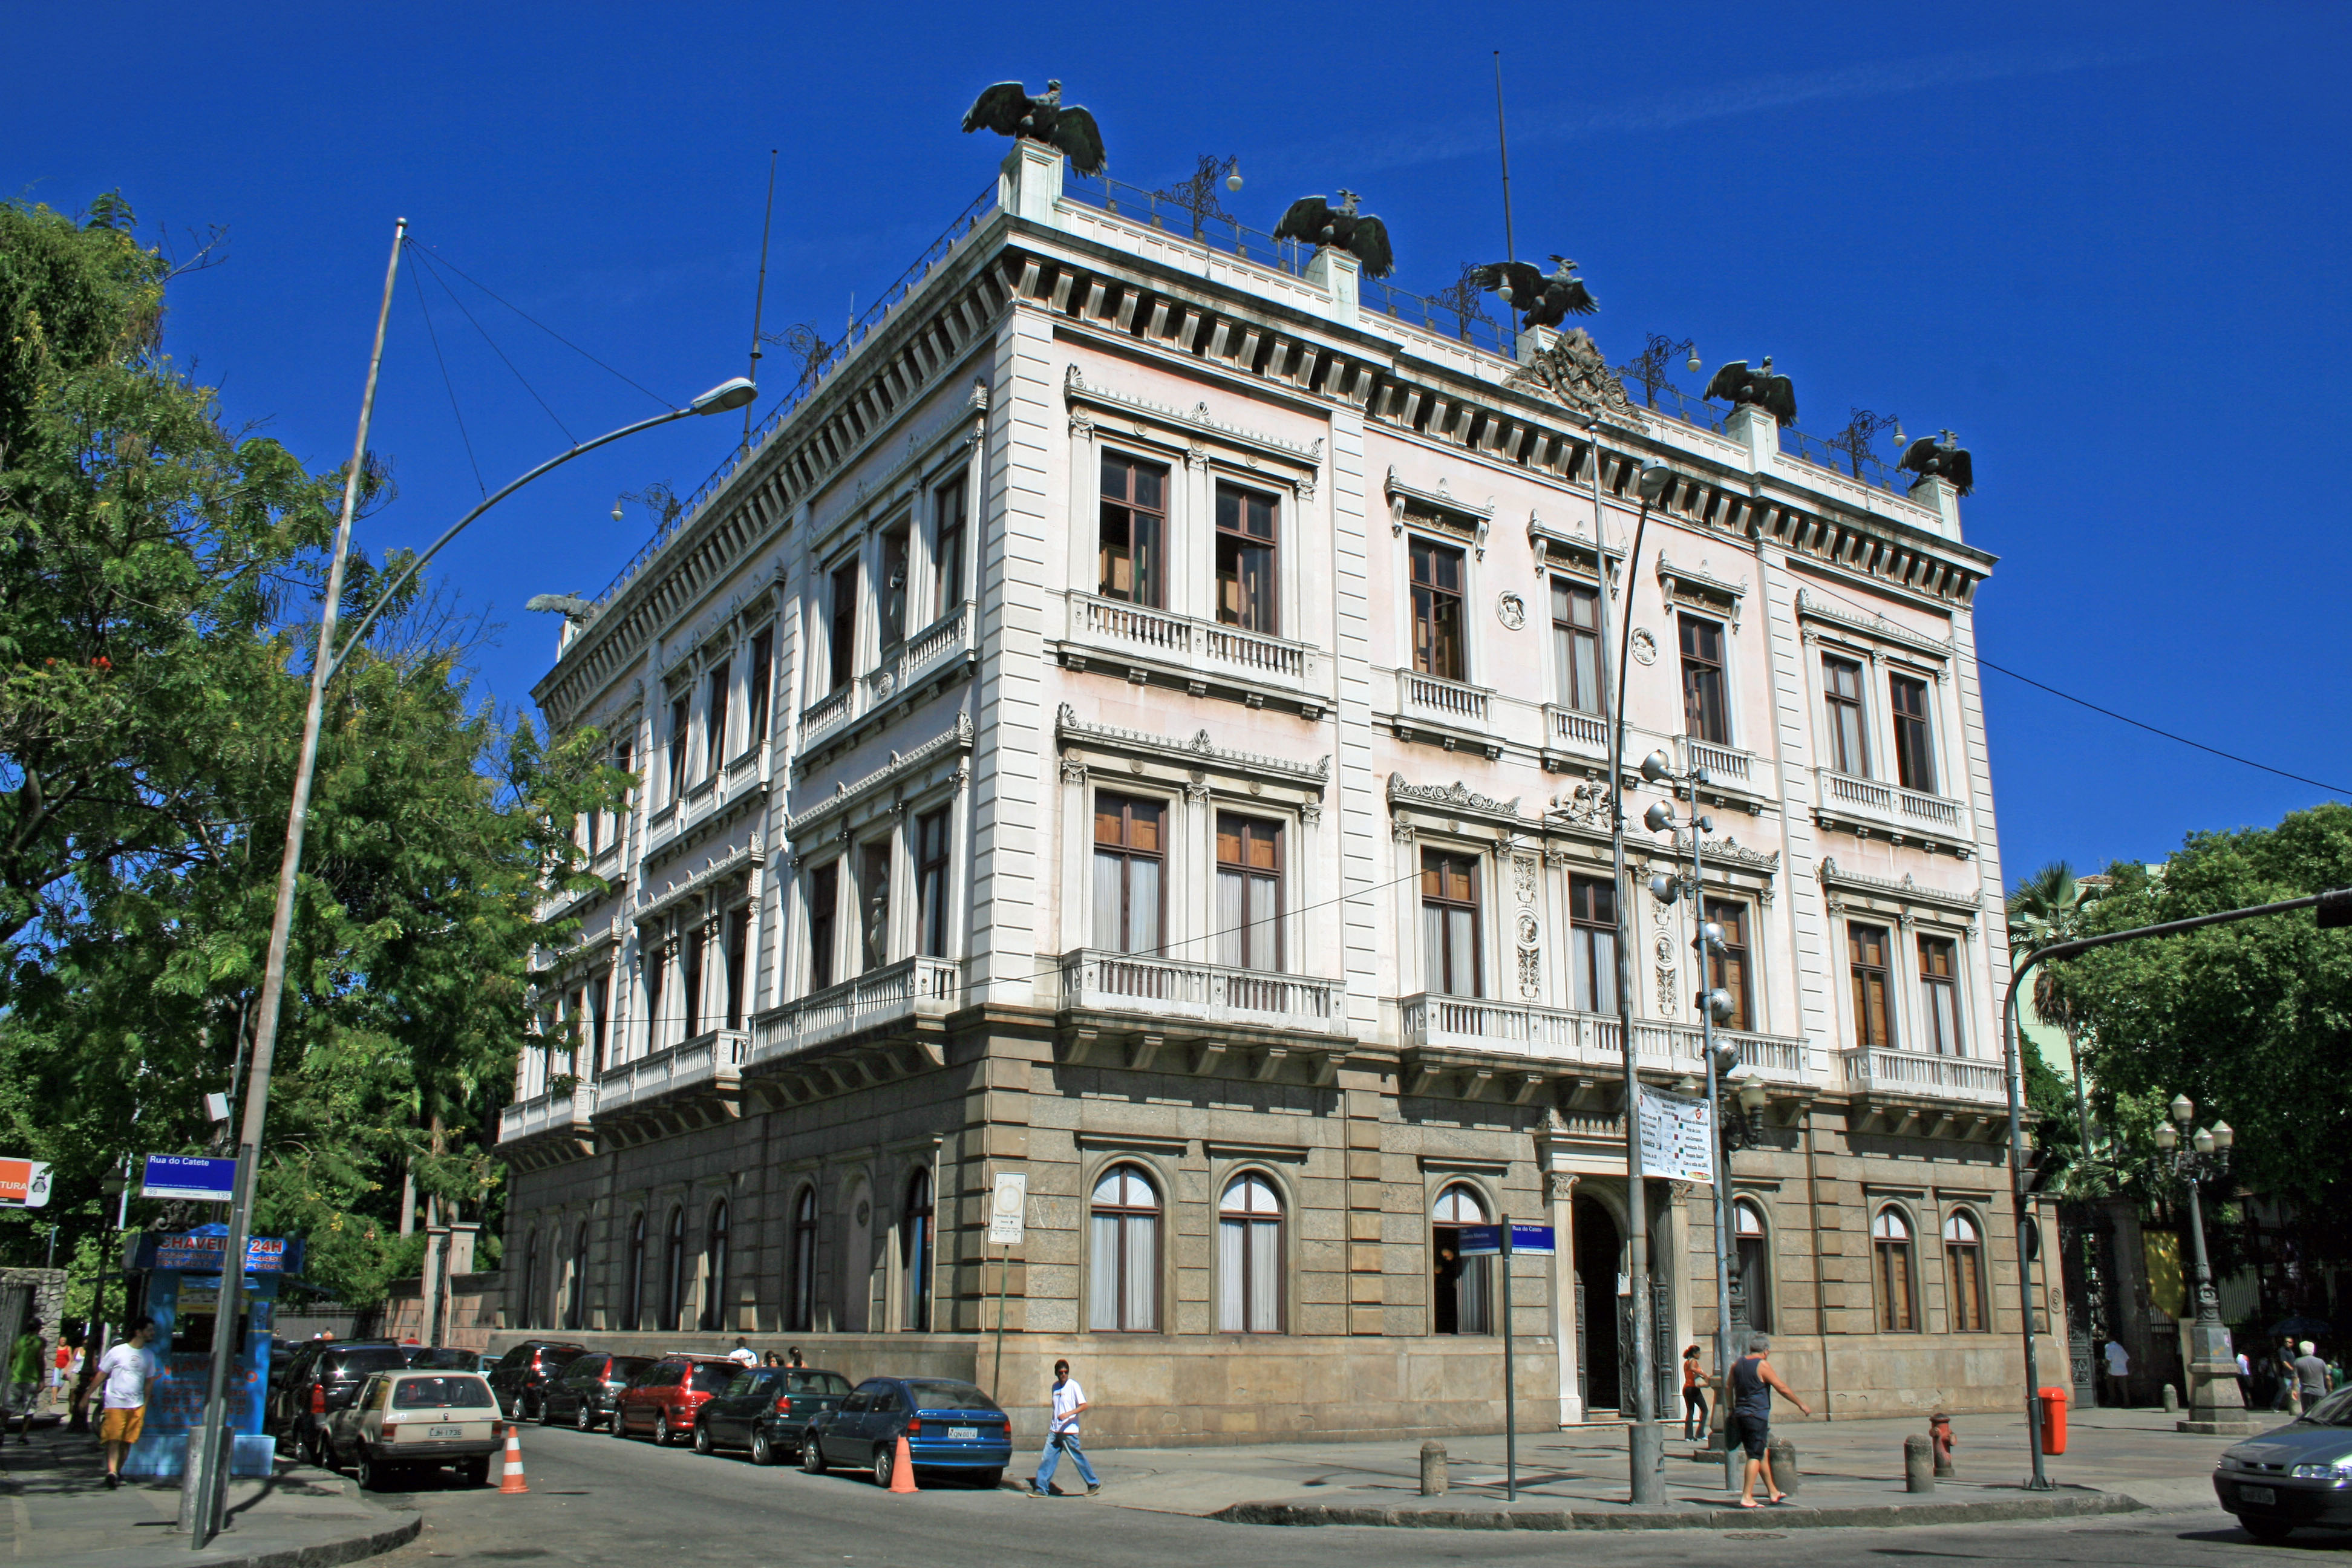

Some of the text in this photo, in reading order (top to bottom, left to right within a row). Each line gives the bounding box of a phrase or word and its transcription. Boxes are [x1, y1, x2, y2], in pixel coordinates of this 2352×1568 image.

[182, 1158, 209, 1166] Catete
[0, 1181, 28, 1191] TURA
[251, 1240, 283, 1253] 24H
